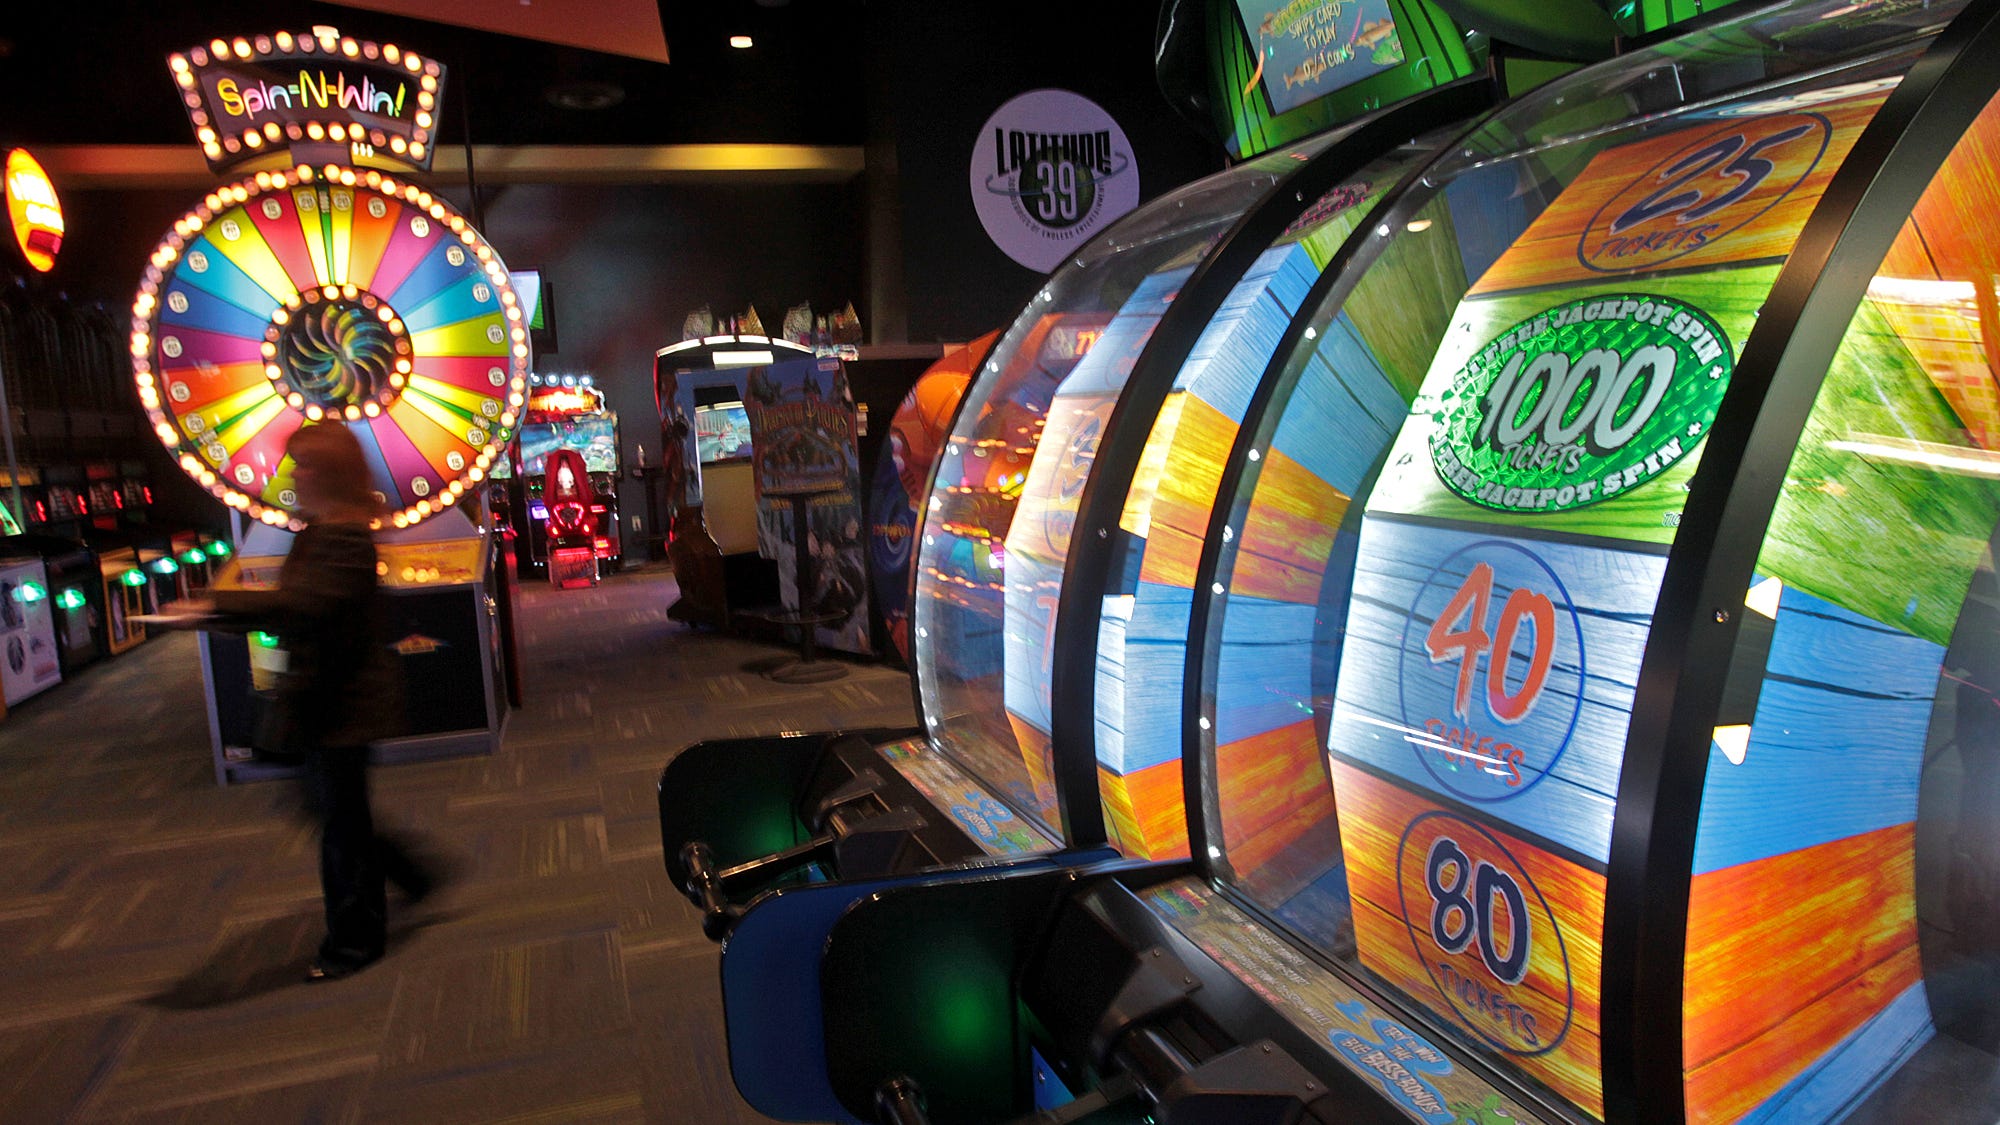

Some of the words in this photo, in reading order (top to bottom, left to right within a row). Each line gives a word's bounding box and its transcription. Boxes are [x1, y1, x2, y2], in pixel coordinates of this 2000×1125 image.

[1288, 14, 1315, 39] SWIPE
[1317, 2, 1342, 25] CARD
[1303, 33, 1317, 50] TO
[1315, 21, 1337, 46] PLAY
[995, 126, 1113, 178] LATITUDE
[1609, 122, 1816, 237] 25
[1036, 160, 1079, 221] 39
[1591, 222, 1721, 261] TICKETS
[1552, 299, 1675, 329] JACKPOT
[1666, 311, 1723, 367] SPIN
[1476, 344, 1679, 451] 1000
[1476, 478, 1597, 508] JACKPOT
[1602, 436, 1684, 496] SPIN
[1499, 440, 1587, 474] TICKETS
[281, 493, 295, 503] 40
[1424, 561, 1556, 725] 40
[1423, 718, 1526, 788] TICKETS
[1424, 835, 1532, 986] 80
[1383, 1023, 1414, 1041] TRY
[1436, 962, 1541, 1048] TICKETS
[1341, 1036, 1373, 1055] BIG
[1359, 1049, 1411, 1081] BASS
[1393, 1077, 1445, 1114] BONUS
[1389, 1044, 1415, 1061] THE
